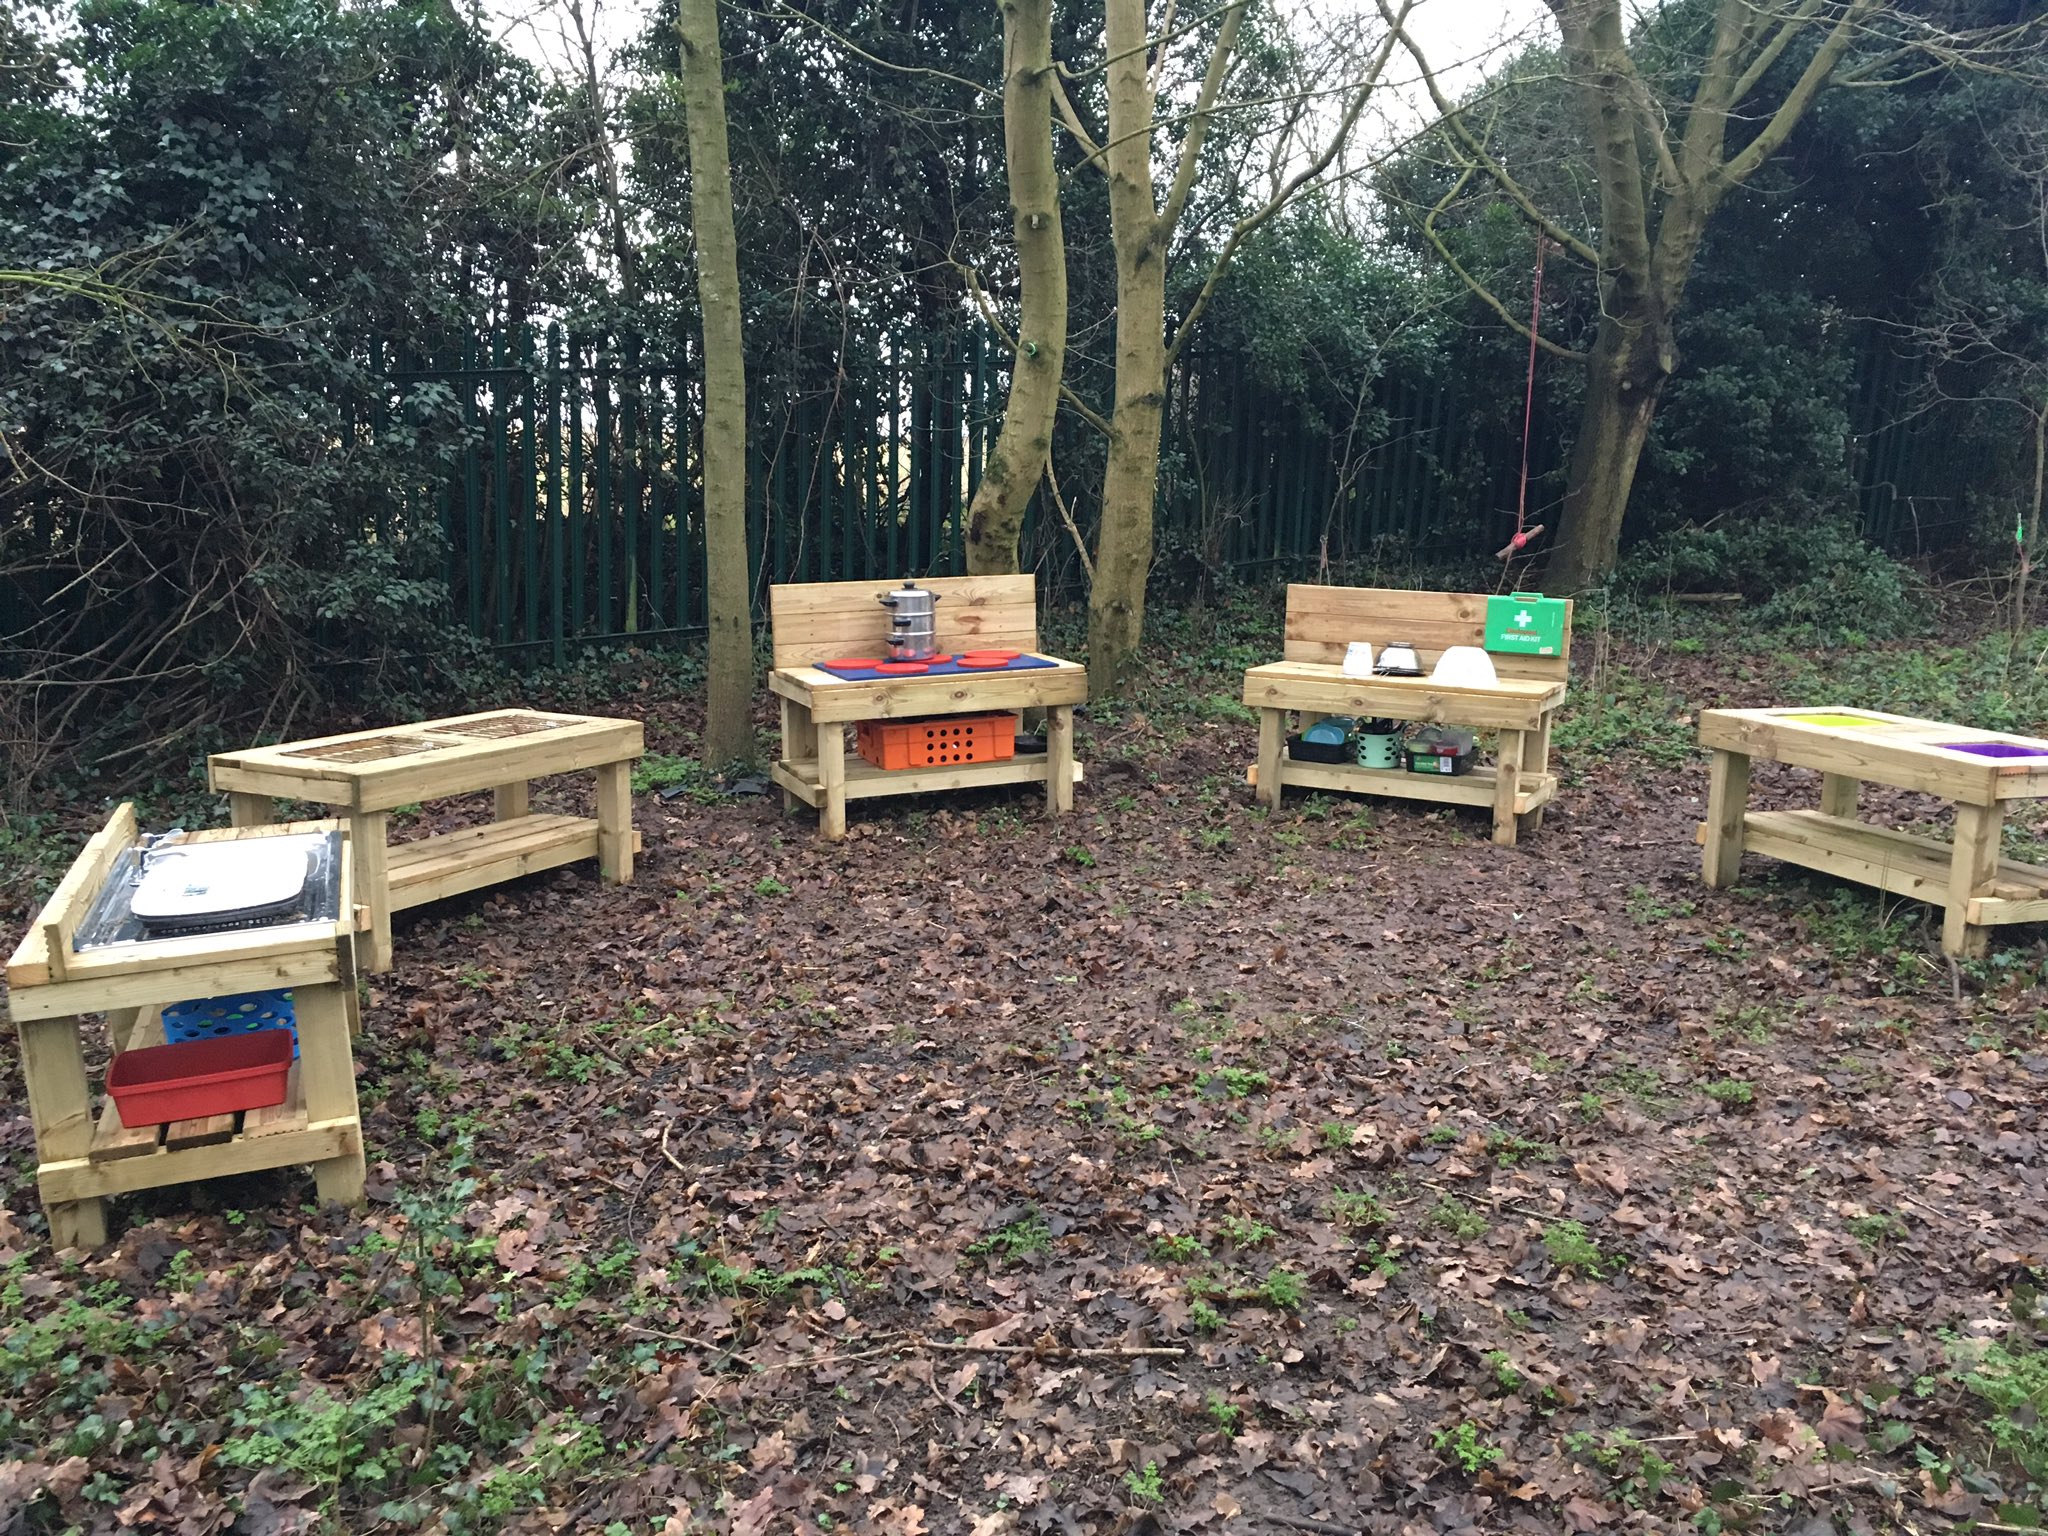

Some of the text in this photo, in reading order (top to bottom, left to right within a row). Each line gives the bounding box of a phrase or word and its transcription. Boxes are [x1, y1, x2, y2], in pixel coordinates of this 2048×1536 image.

[1500, 633, 1541, 643] FIRST AID KIT
